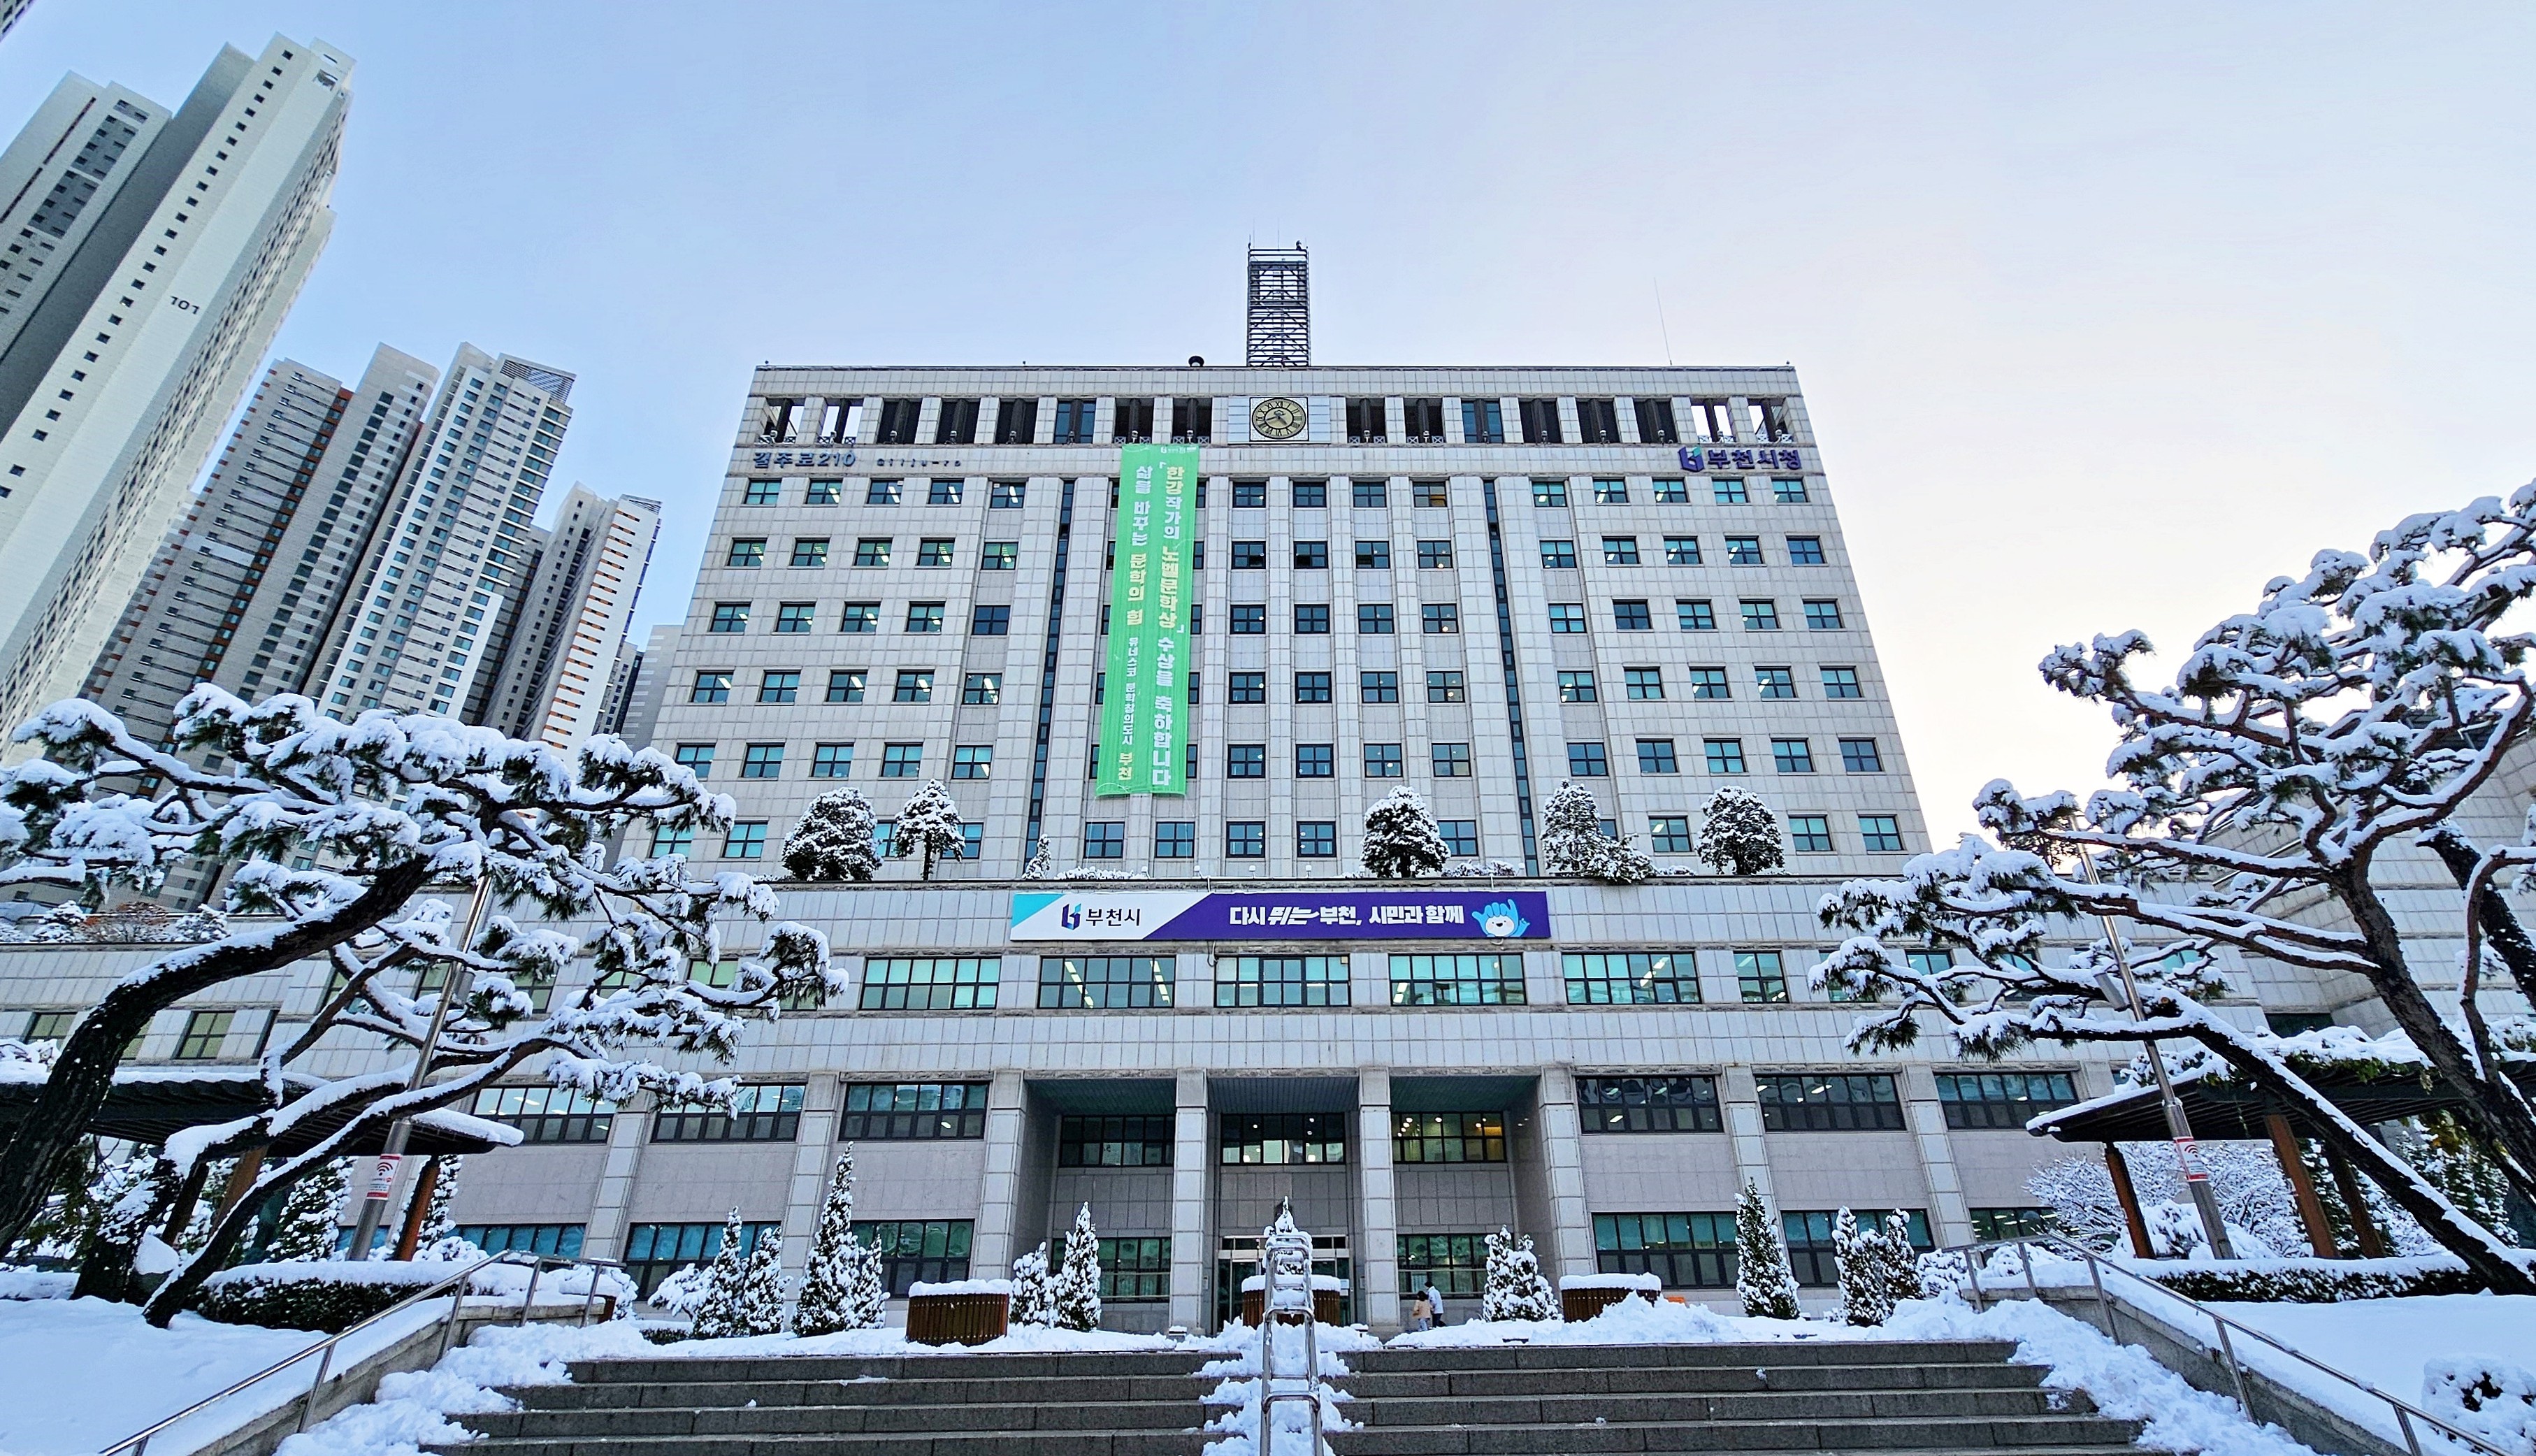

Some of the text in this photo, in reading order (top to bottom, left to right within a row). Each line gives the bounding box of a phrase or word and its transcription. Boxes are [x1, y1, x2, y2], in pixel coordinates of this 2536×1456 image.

[170, 296, 199, 314] 101
[1708, 449, 1802, 470] 부천시청
[1127, 466, 1153, 626] 삶을 바꾸는 문학의 힘
[1156, 637, 1174, 686] 수상을
[1118, 637, 1139, 780] 유네스코 문학창의도시 부천
[1152, 695, 1173, 786] 축하합니다
[1086, 908, 1140, 926] 부천시
[1230, 905, 1464, 925] 다시 뛰는 부천, 시민과 함께
